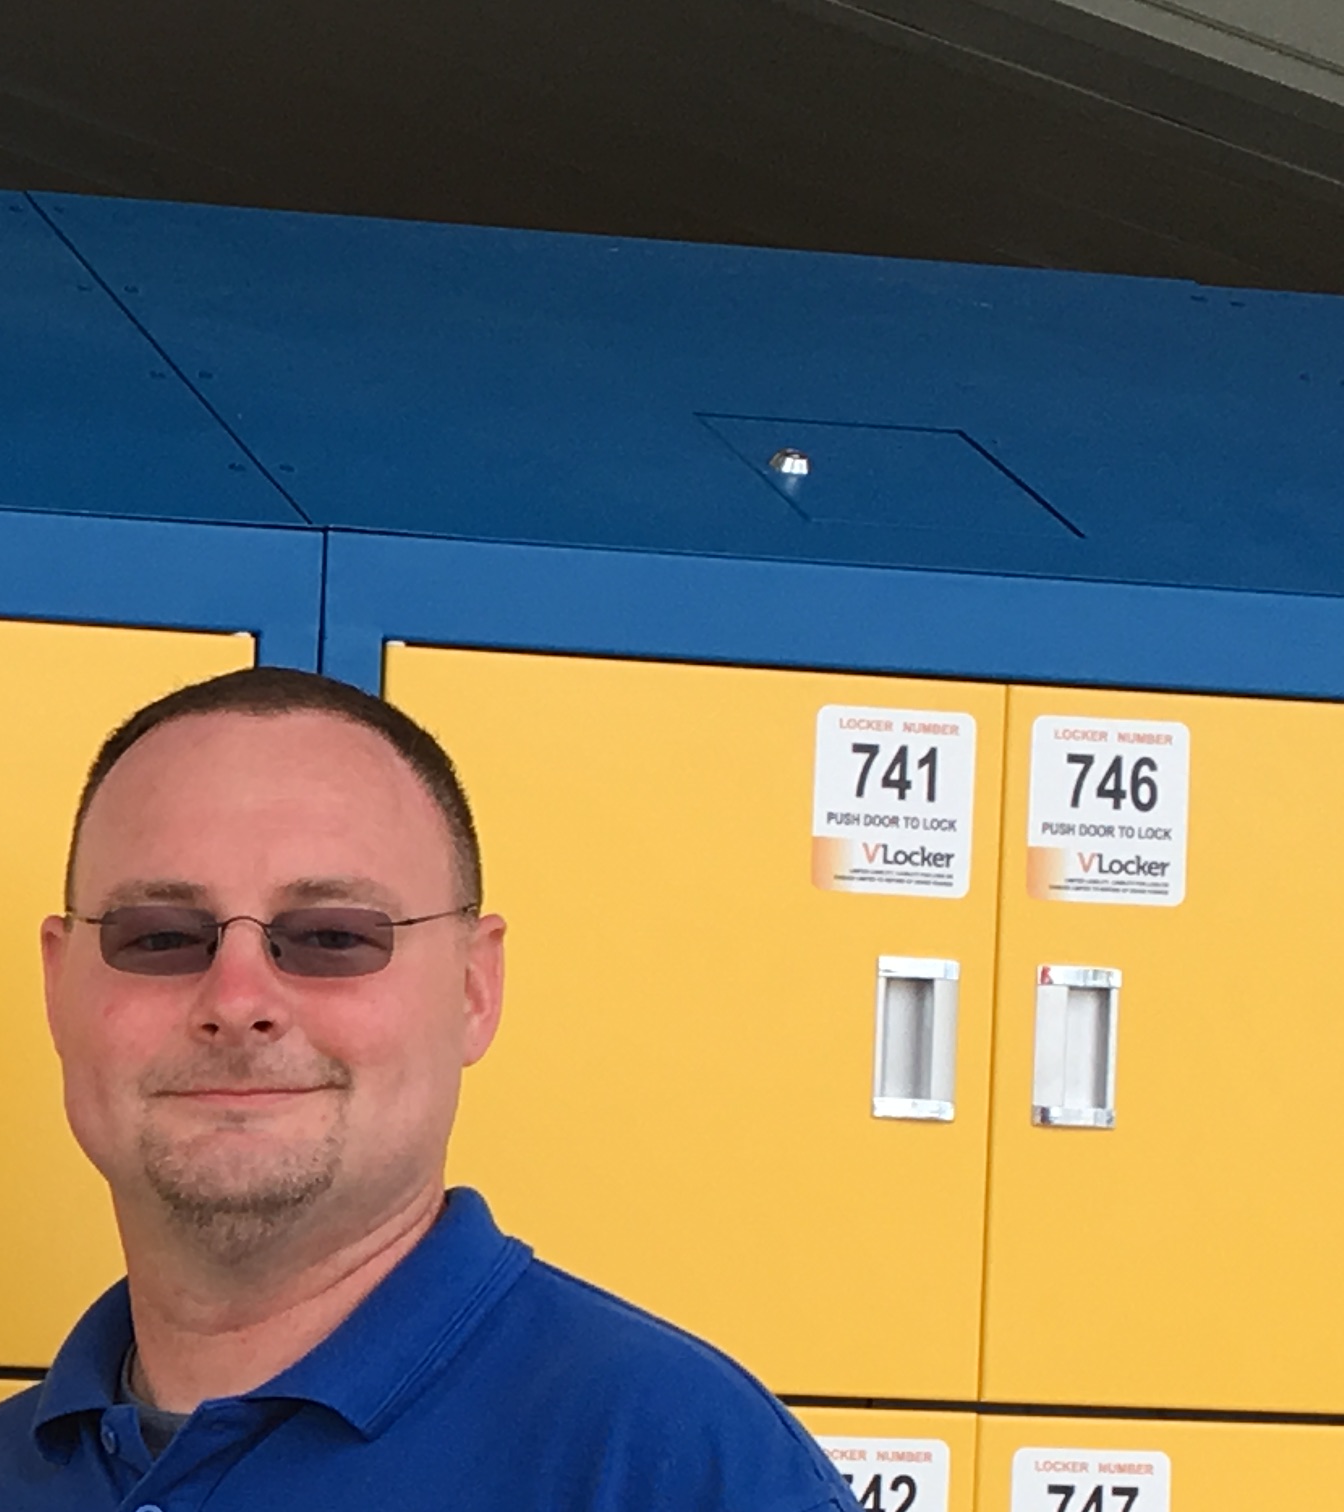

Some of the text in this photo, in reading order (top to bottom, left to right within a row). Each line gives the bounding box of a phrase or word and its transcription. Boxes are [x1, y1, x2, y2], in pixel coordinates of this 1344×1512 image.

[839, 718, 960, 736] LOCKER NUMBER
[1054, 729, 1173, 745] LOCKER NUMBER
[851, 742, 938, 803] 741
[1066, 753, 1159, 812] 746
[827, 812, 957, 832] PUSH DOOR TO LOCK
[1042, 822, 1172, 841] PUSH DOOR TO LOCK
[862, 842, 955, 869] VLocker
[1077, 852, 1171, 878] VLocker
[877, 1451, 932, 1463] NUMBER
[1035, 1461, 1154, 1475] LOCKER NUMBER
